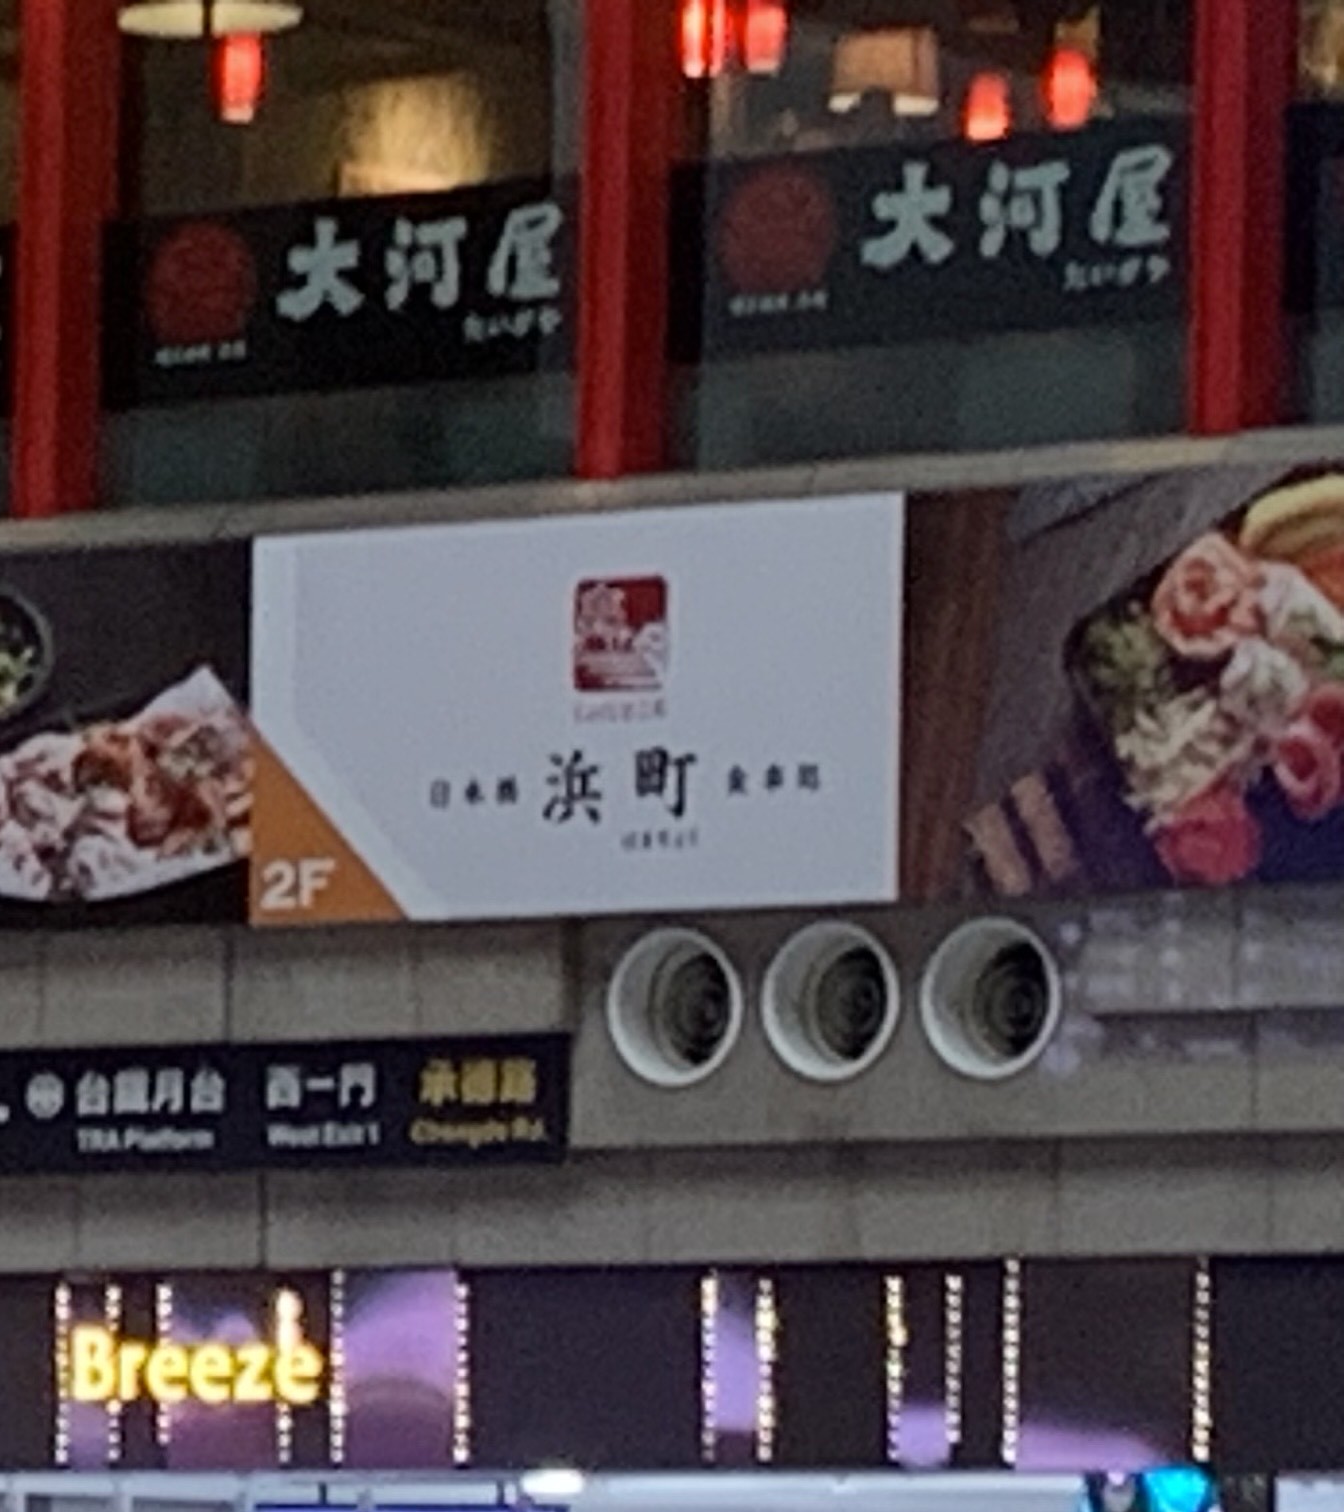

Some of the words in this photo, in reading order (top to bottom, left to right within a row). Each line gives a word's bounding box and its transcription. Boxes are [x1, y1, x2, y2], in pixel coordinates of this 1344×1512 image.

[861, 143, 1174, 270] 大河屋
[276, 204, 564, 321] 大河屋
[542, 746, 698, 825] 浜町
[260, 859, 336, 911] 2F
[70, 1325, 323, 1404] Breeze
